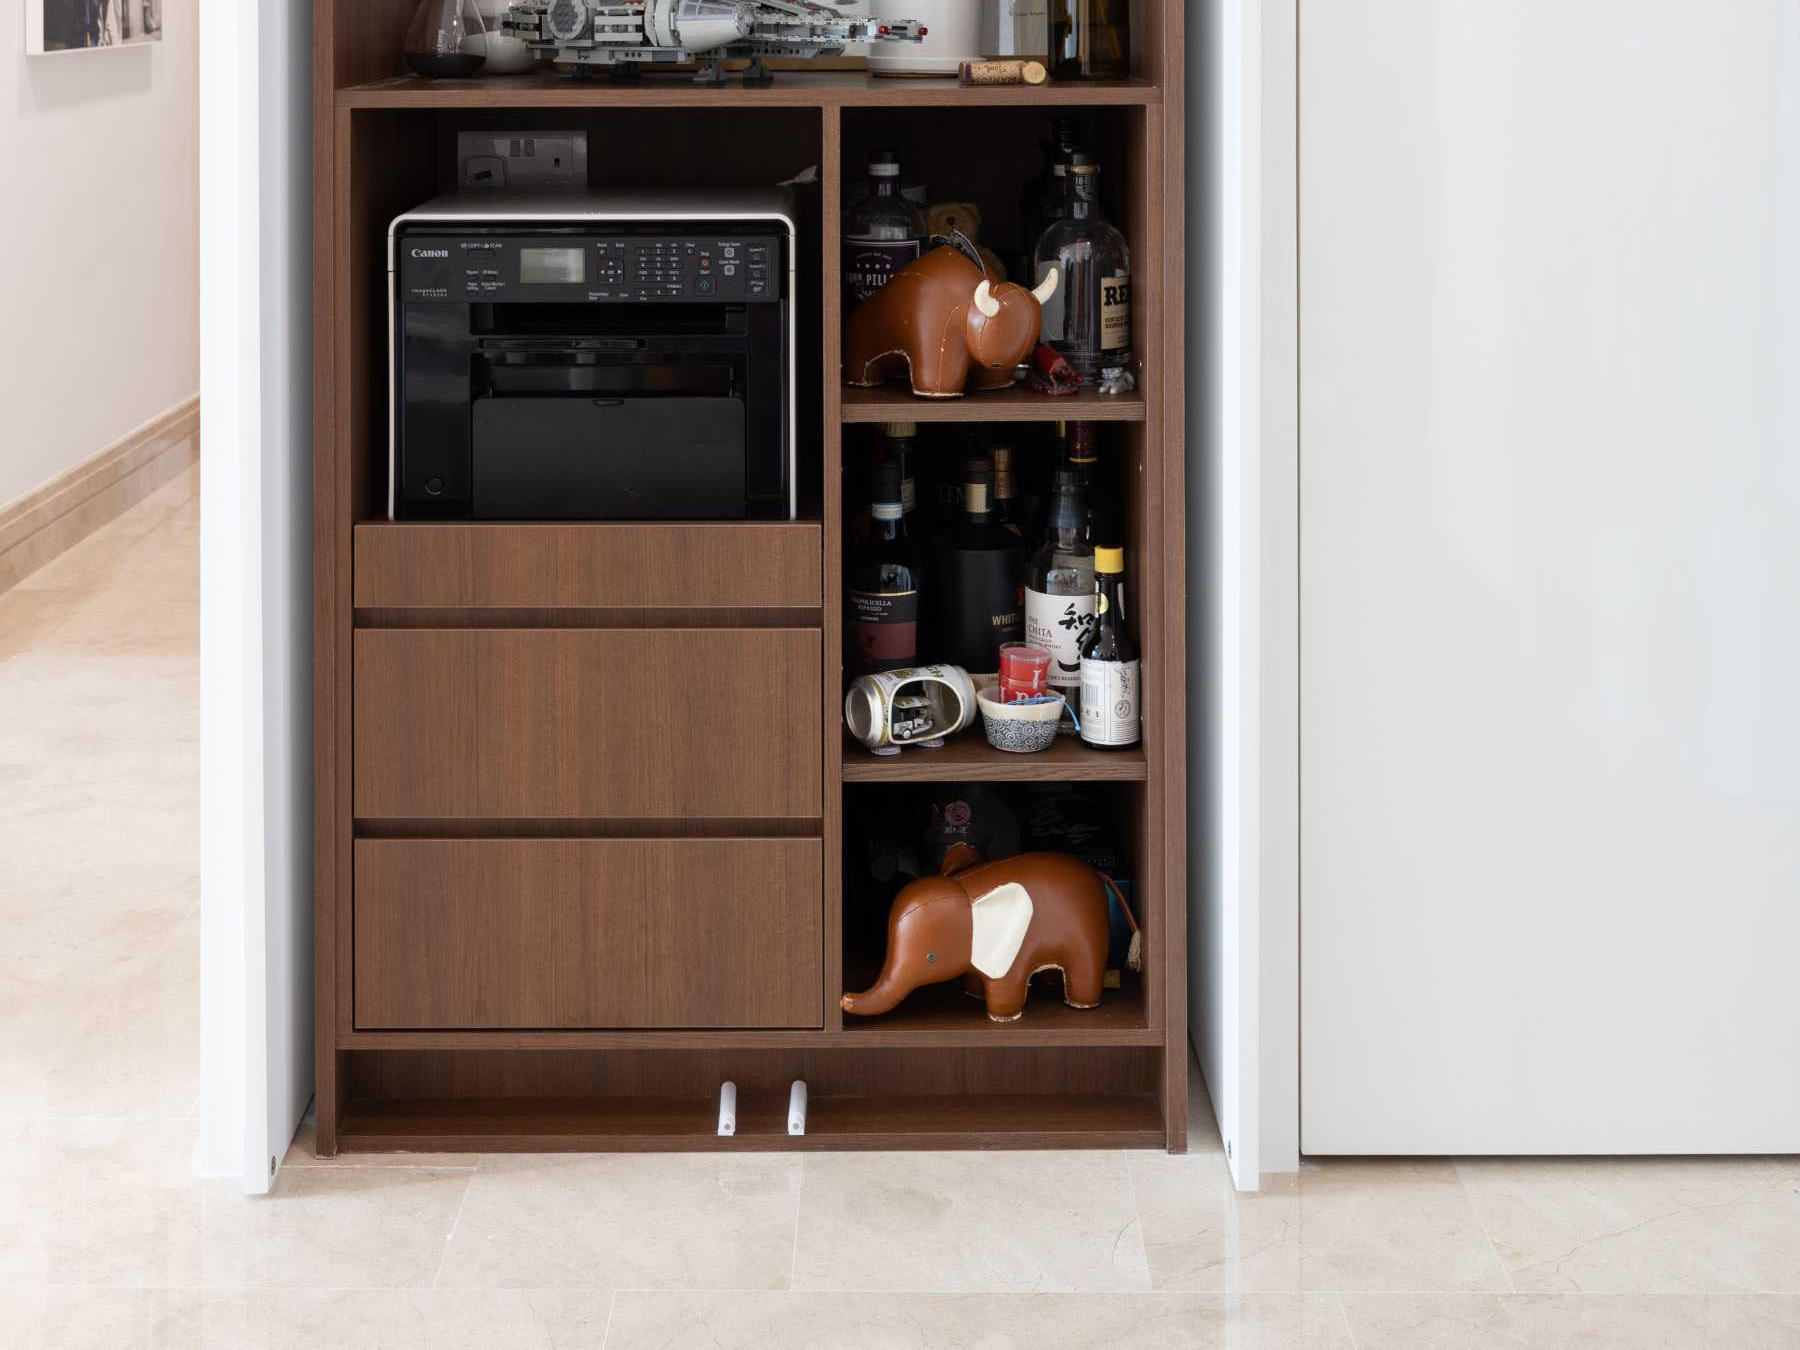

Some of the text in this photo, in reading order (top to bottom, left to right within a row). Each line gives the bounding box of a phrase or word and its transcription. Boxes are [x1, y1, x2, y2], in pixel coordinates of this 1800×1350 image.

[411, 248, 449, 258] Canon
[992, 613, 1018, 626] WHIT
[1028, 625, 1053, 638] CHITA
